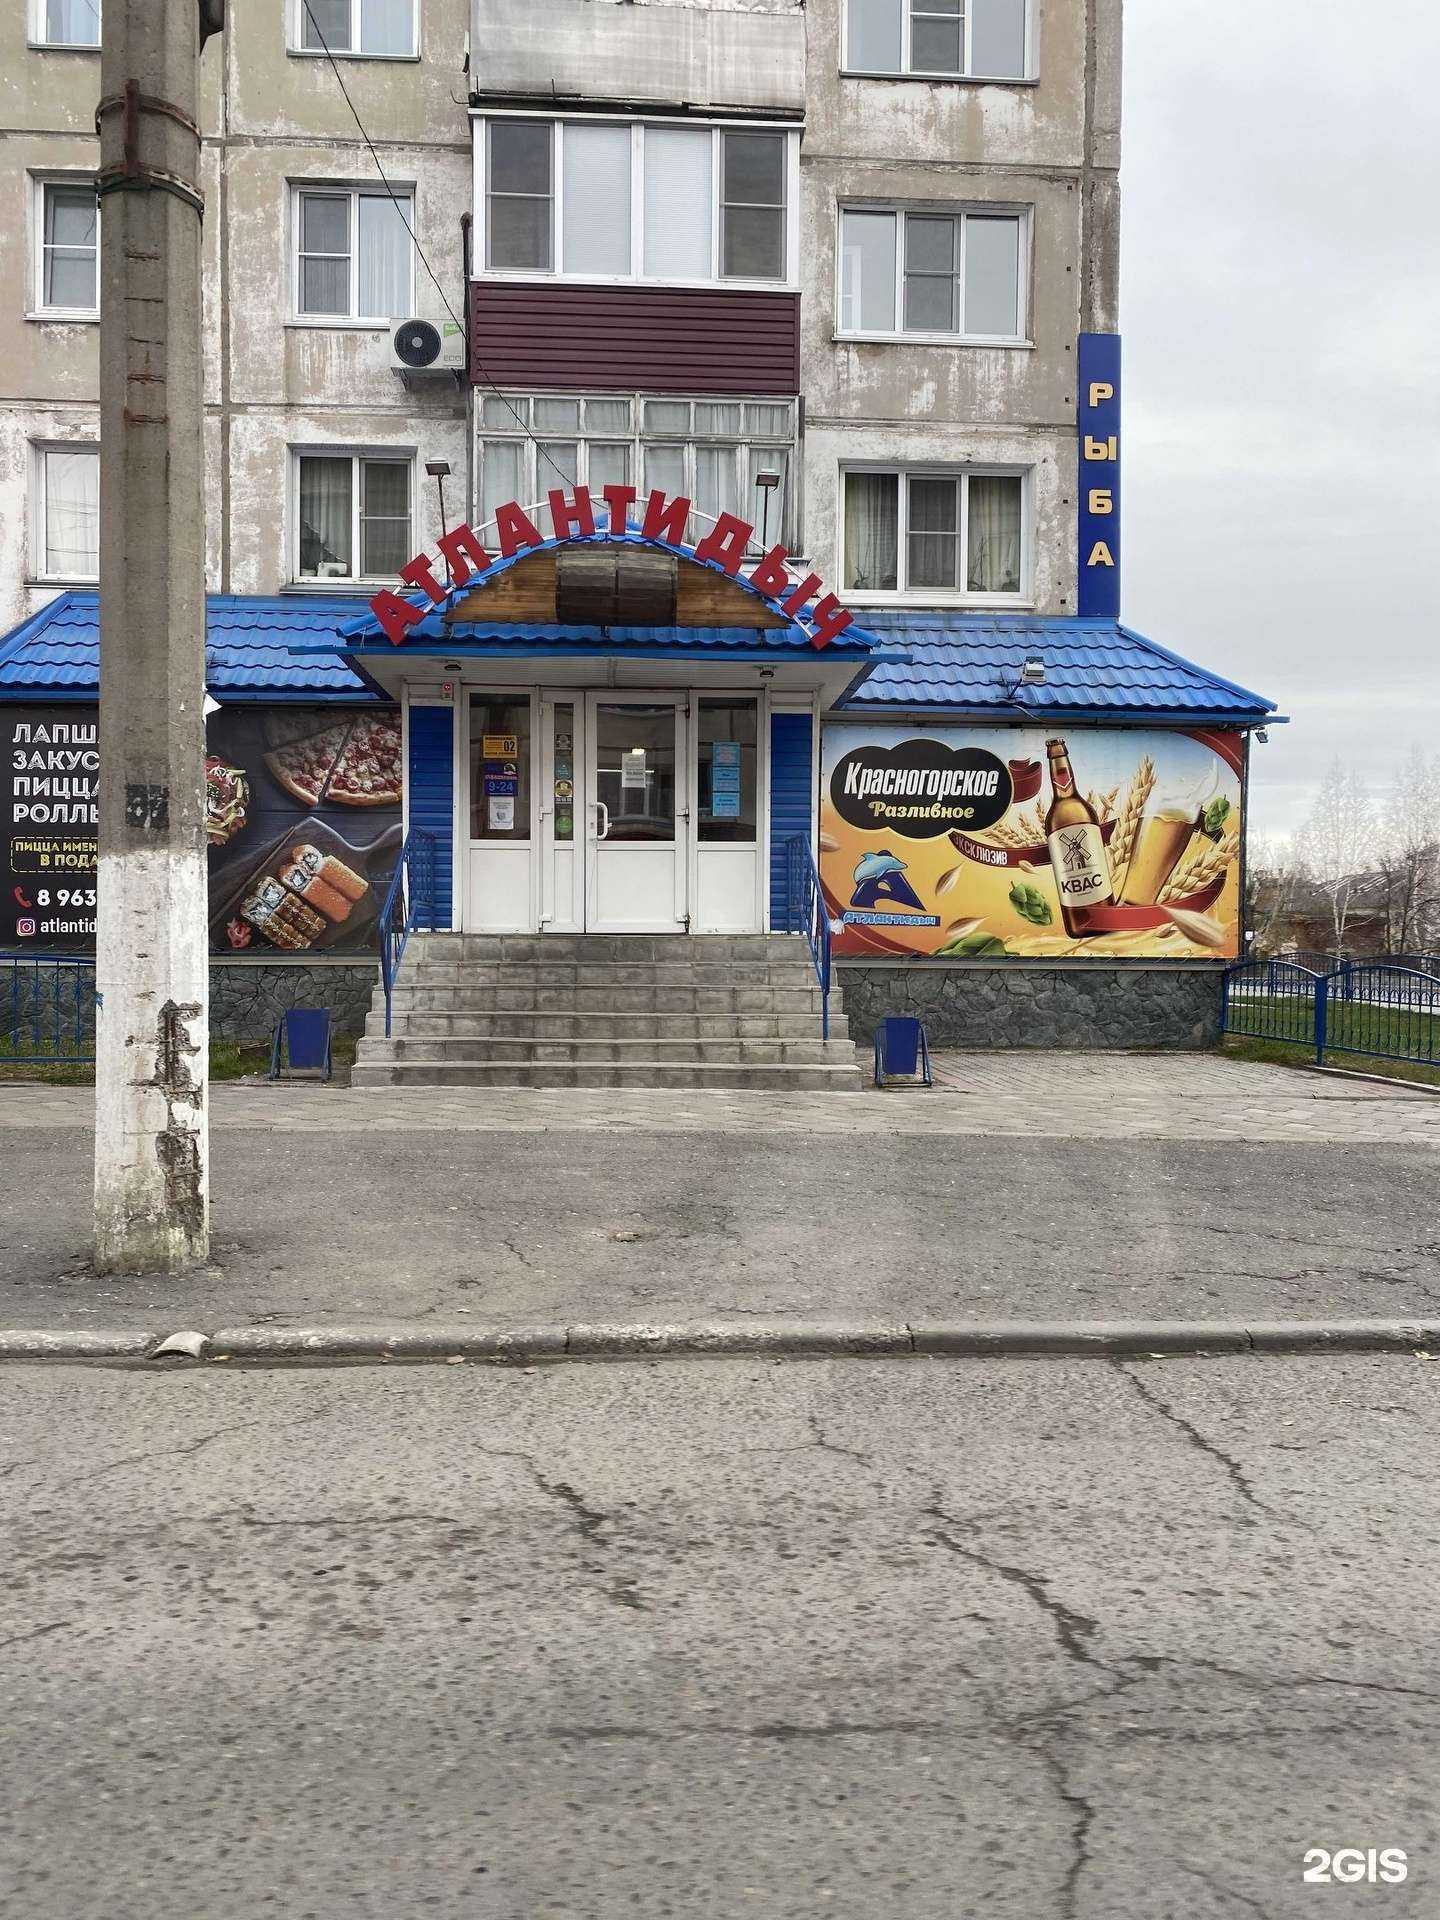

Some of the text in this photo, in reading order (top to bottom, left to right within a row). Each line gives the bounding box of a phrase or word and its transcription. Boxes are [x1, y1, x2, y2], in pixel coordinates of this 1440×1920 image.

[1084, 382, 1117, 567] РЫБА
[369, 485, 854, 650] АТЛАНТИДЫЧ
[12, 723, 99, 744] ЛАПШ
[844, 762, 999, 801] Красногорское
[868, 801, 974, 819] Разливное
[15, 842, 97, 852] ПИЦЦА ИМЕН
[40, 854, 50, 866] В
[1061, 873, 1103, 894] КВАС
[37, 889, 97, 906] 8 963
[40, 917, 97, 933] atlantid
